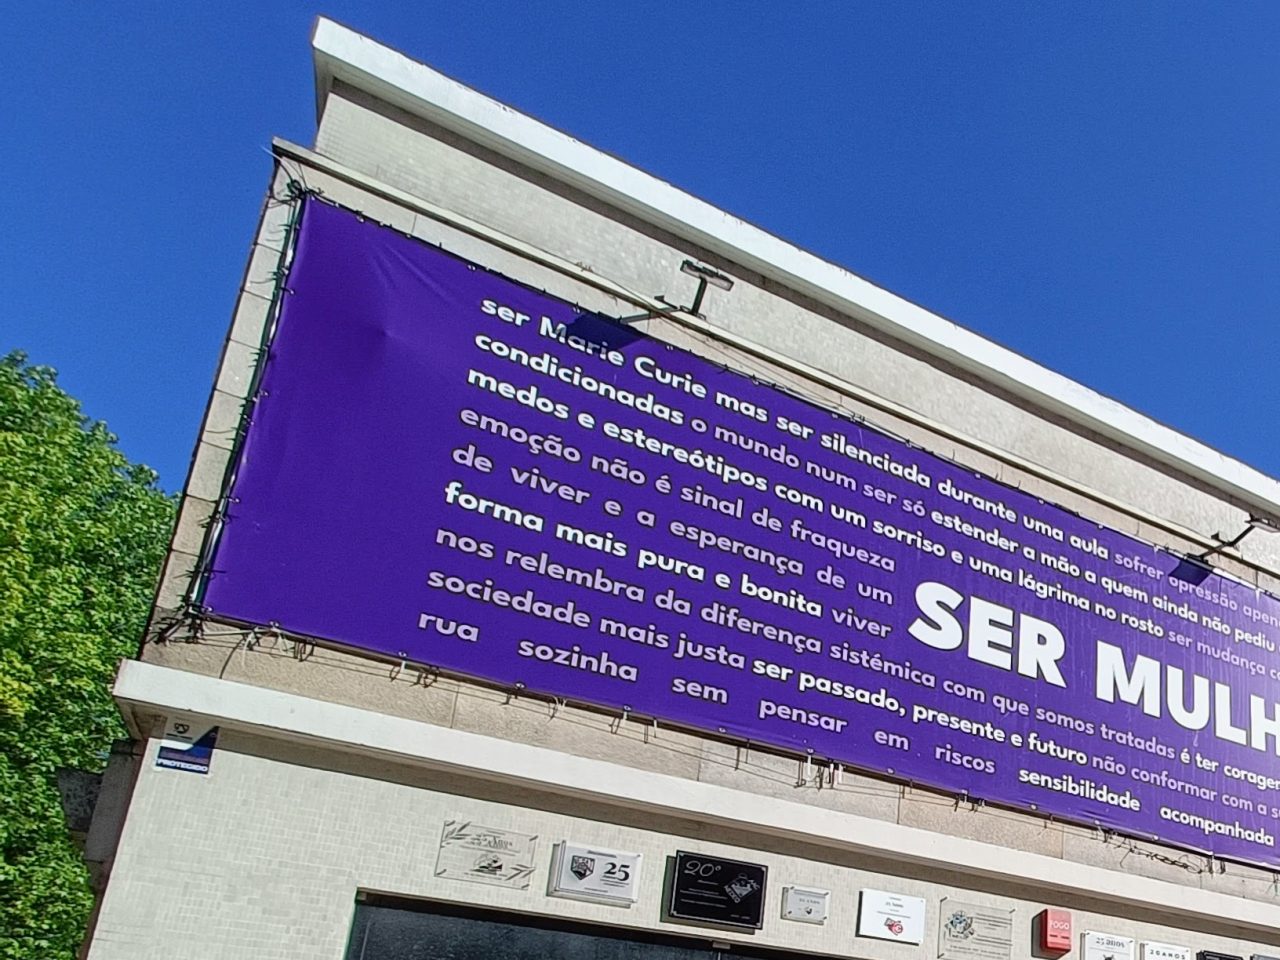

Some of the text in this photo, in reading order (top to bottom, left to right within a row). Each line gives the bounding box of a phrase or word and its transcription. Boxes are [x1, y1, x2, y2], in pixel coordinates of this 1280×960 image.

[460, 409, 895, 572] emoção não sinal fraqueza
[467, 368, 570, 419] medos
[603, 422, 768, 491] estereótipos
[774, 484, 824, 513] com
[872, 520, 946, 557] sorriso
[968, 556, 1013, 583] uma
[1018, 568, 1090, 611] lágrima
[1121, 612, 1164, 638] rosto
[1168, 630, 1194, 648] ser
[1196, 641, 1266, 676] mudança
[474, 334, 684, 425] condicionadas
[714, 426, 800, 468] mundo
[806, 461, 857, 491] num
[862, 484, 898, 505] ser
[930, 510, 1019, 553] estender
[1040, 552, 1081, 577] mão
[1100, 576, 1149, 604] quem
[1152, 595, 1199, 623] ainda
[1201, 615, 1232, 635] não
[1234, 627, 1275, 652] pediu
[481, 299, 531, 326] ser
[539, 316, 625, 366] Marie
[634, 356, 707, 399] Curie
[715, 391, 768, 422] mas
[776, 416, 814, 439] ser
[820, 432, 931, 489] silenciada
[937, 478, 1017, 523] durante
[1022, 515, 1064, 542] uma
[1069, 535, 1109, 560] aula
[1114, 553, 1165, 580] sofrer
[1168, 576, 1238, 611] opressão
[510, 467, 804, 576] viver esperança
[435, 528, 494, 558] nos
[505, 550, 645, 603] relembra
[700, 602, 822, 654] diferença
[829, 642, 936, 688] sistémica
[942, 680, 985, 703] com
[992, 695, 1030, 716] que
[1035, 707, 1095, 735] somos
[1099, 723, 1175, 759] tratadas
[1195, 752, 1220, 772] ter
[444, 481, 892, 638] forma mais pura bonita viver
[908, 581, 1066, 687] SER
[157, 758, 208, 773] PROTEGIDO
[418, 613, 479, 642] rua
[518, 640, 638, 682] sozinha
[671, 678, 728, 704] sem
[759, 699, 848, 733] pensar
[935, 743, 995, 774] riscos
[1018, 769, 1141, 812] sensibilidade
[1159, 806, 1275, 847] acompanhada
[427, 571, 591, 628] sociedade
[599, 618, 669, 648] mais
[673, 632, 745, 669] justa
[752, 659, 794, 681] ser
[799, 672, 906, 717] passado,
[912, 704, 1006, 742] presente
[1027, 732, 1088, 765] futuro
[1092, 755, 1126, 776] não
[1130, 767, 1218, 802] conformar
[1221, 794, 1253, 812] com
[604, 861, 630, 882] 25
